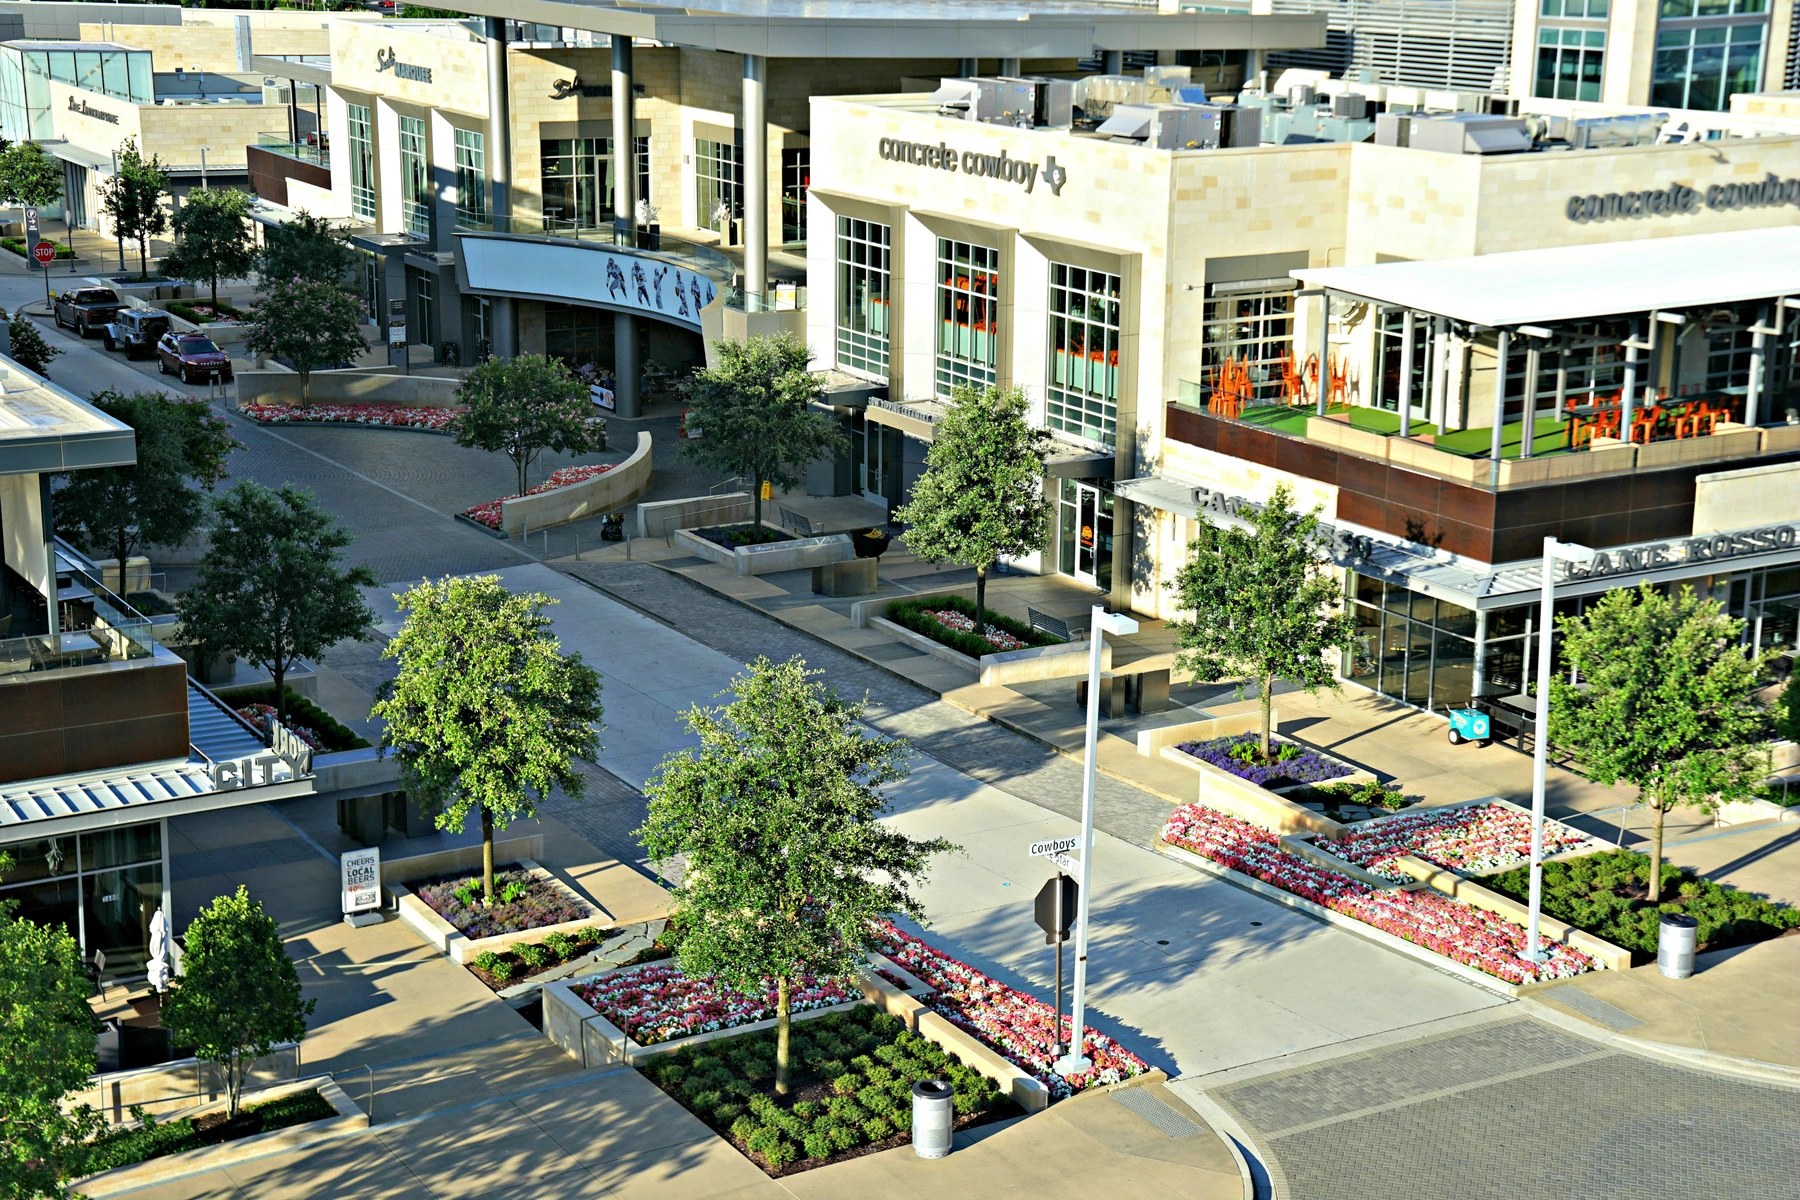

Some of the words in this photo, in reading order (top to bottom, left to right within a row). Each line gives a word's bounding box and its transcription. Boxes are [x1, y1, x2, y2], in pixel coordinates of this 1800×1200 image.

[394, 61, 432, 84] MARQUEE
[879, 137, 958, 172] concrete
[961, 149, 1039, 194] cowboy
[1566, 182, 1698, 222] concrete
[1705, 172, 1800, 211] cowbo
[35, 248, 54, 256] STOP
[1564, 543, 1670, 581] CANE
[1682, 525, 1796, 562] ROSSO
[213, 751, 309, 790] CITY
[1031, 838, 1076, 855] Cowboys
[347, 857, 375, 868] CHEERS
[347, 867, 375, 877] LOCAL
[348, 874, 375, 885] BEERS
